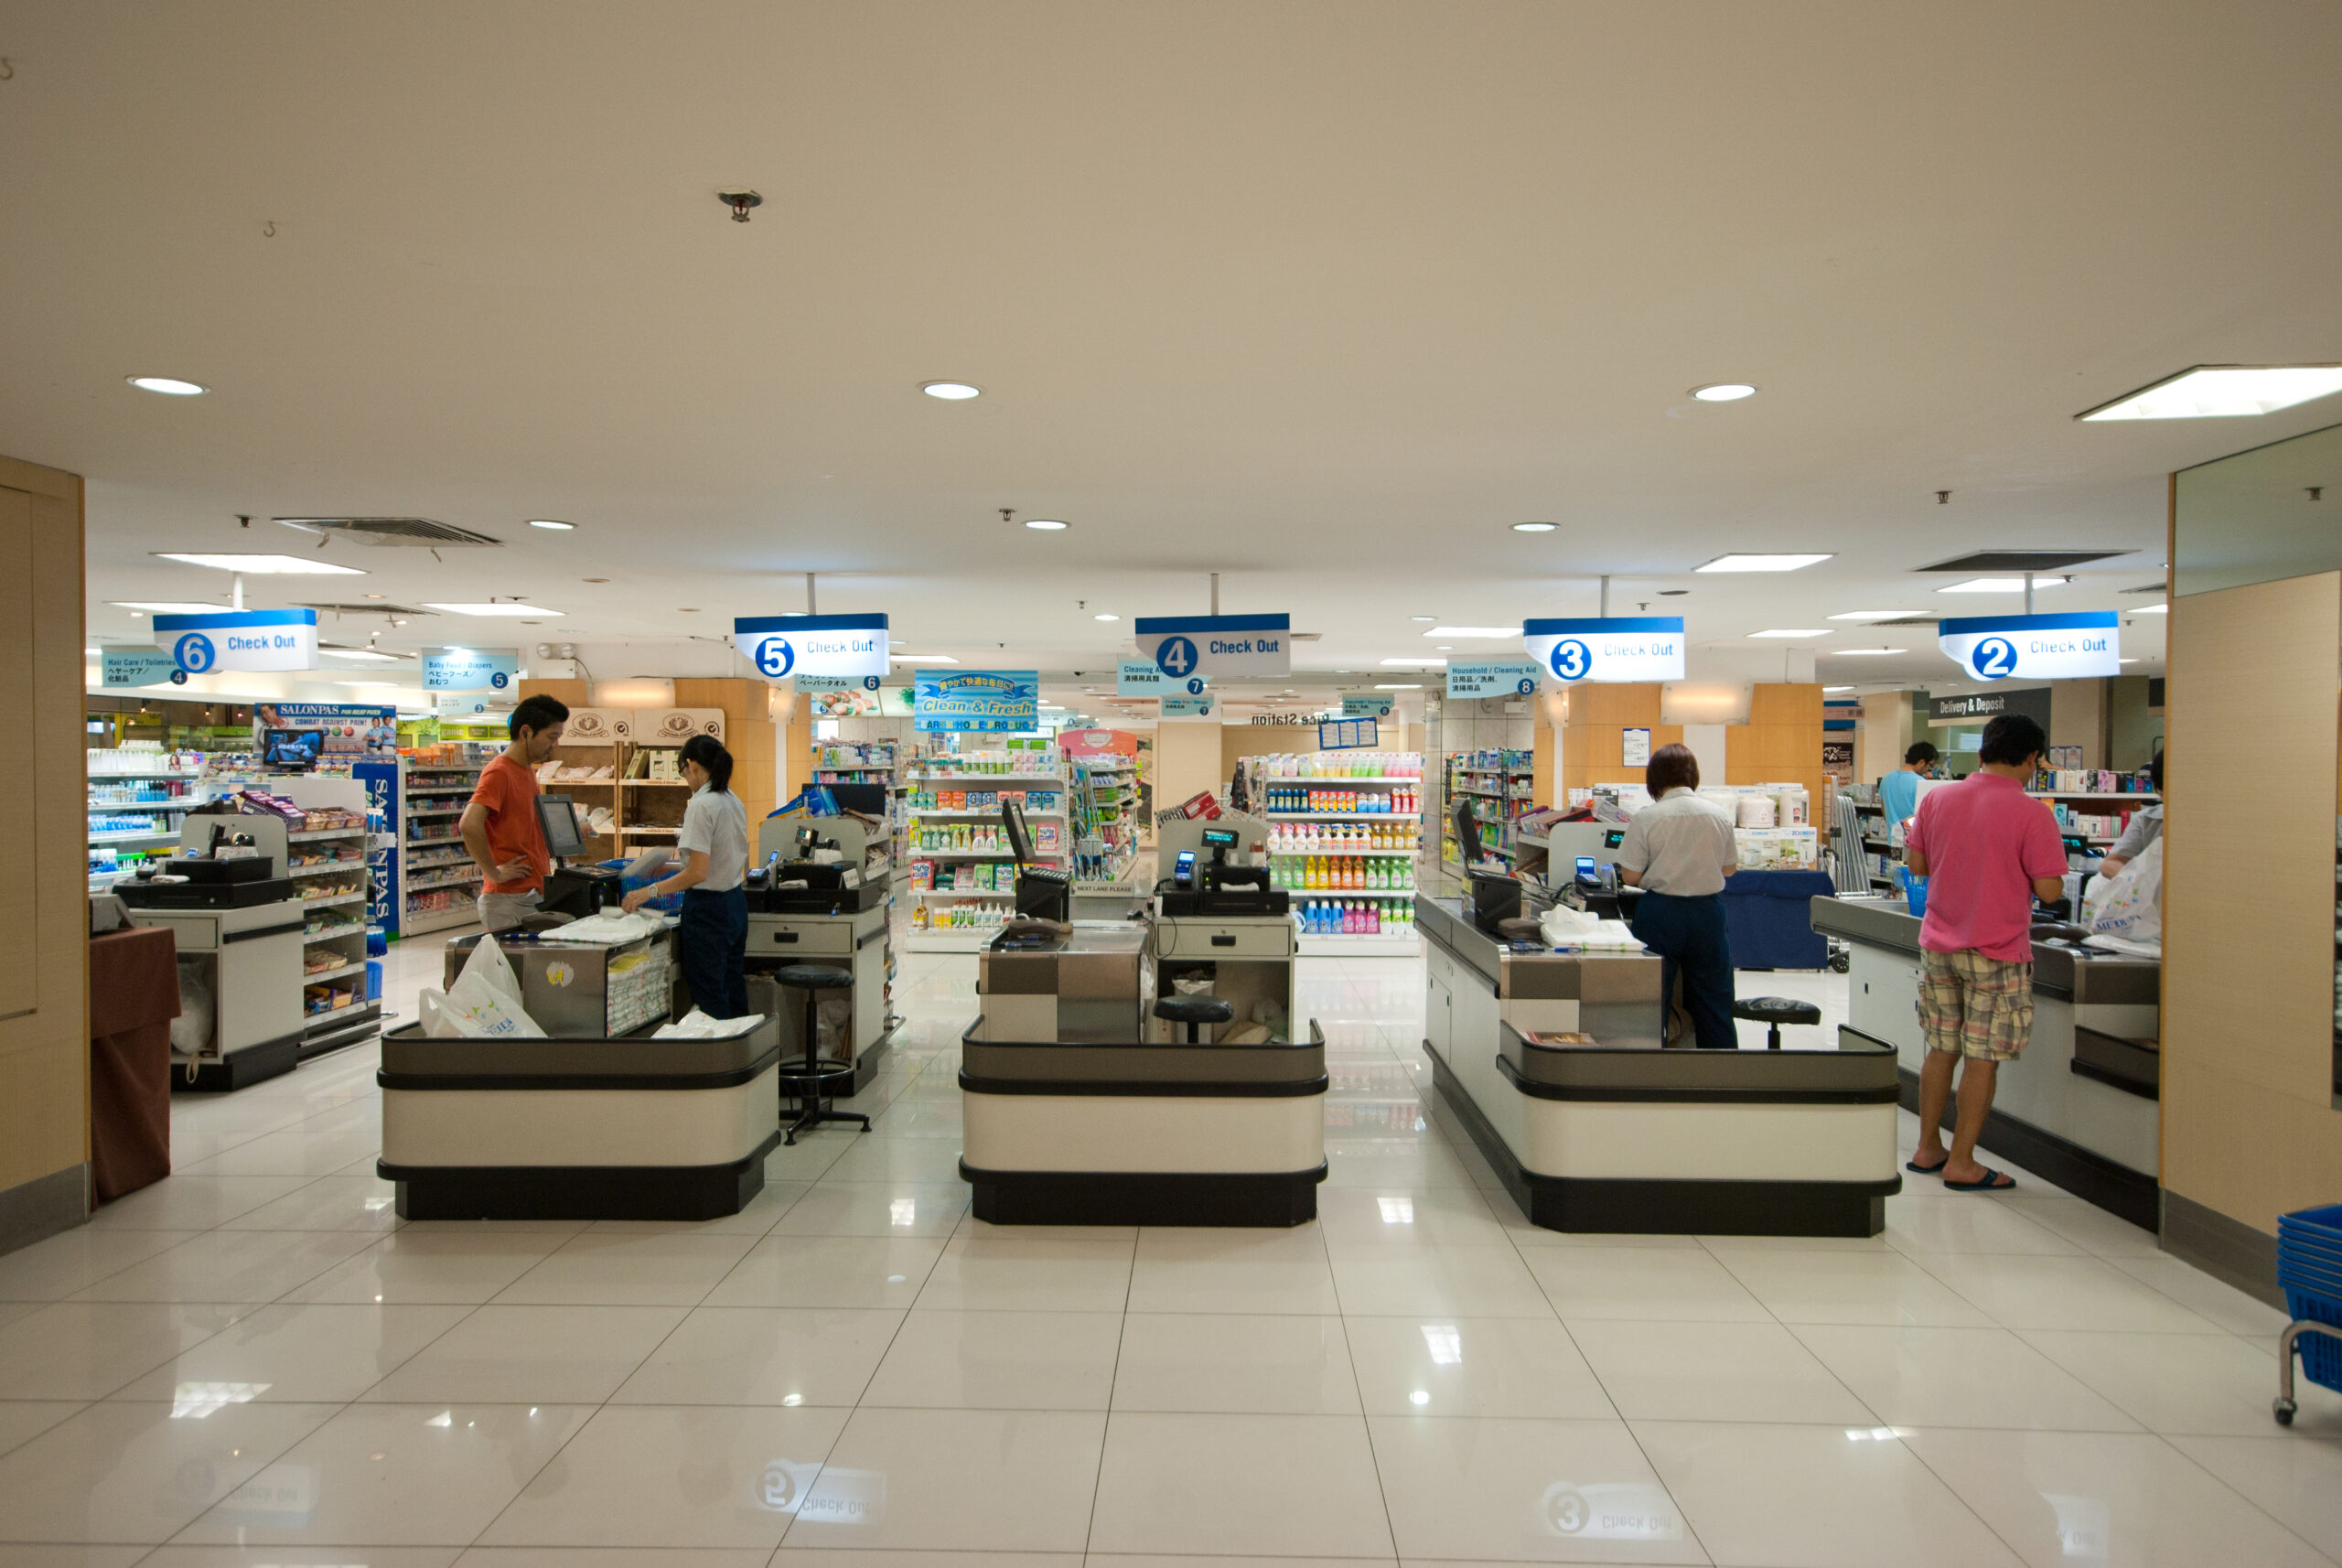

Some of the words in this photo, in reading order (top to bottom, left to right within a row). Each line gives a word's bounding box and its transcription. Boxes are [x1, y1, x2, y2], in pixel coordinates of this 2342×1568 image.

[228, 636, 270, 650] Check
[274, 635, 295, 649] Out
[808, 640, 846, 652] Check
[852, 639, 873, 651] Out
[1209, 640, 1252, 654] Check
[1257, 639, 1279, 652] Out
[2030, 640, 2076, 653] Check
[2082, 639, 2107, 651] Out
[183, 637, 207, 671] 6
[1605, 644, 1646, 656] Check
[1651, 643, 1673, 656] Out
[145, 659, 177, 667] Toiletries
[764, 640, 786, 674] 5
[1164, 640, 1187, 673] 4
[1559, 642, 1584, 678] 3
[1982, 639, 2009, 675] 2
[428, 661, 444, 670] Baby
[467, 661, 492, 670] Diapers
[1124, 666, 1154, 674] Cleaning
[1452, 666, 1488, 675] Household
[1494, 666, 1523, 675] Cleaning
[1525, 666, 1537, 674] Aid
[174, 672, 183, 683] 4
[496, 674, 504, 686] 5
[867, 679, 876, 689] 6
[1192, 681, 1199, 693] 7
[1521, 681, 1531, 693] 8
[281, 705, 338, 715] SALONPAS
[923, 699, 967, 713] Clean
[972, 701, 983, 714] &
[989, 701, 1033, 715] Fresh
[1940, 701, 1967, 714] Delivery
[1968, 698, 1975, 711] &
[1976, 696, 2004, 714] Deposit
[957, 720, 985, 729] HOME
